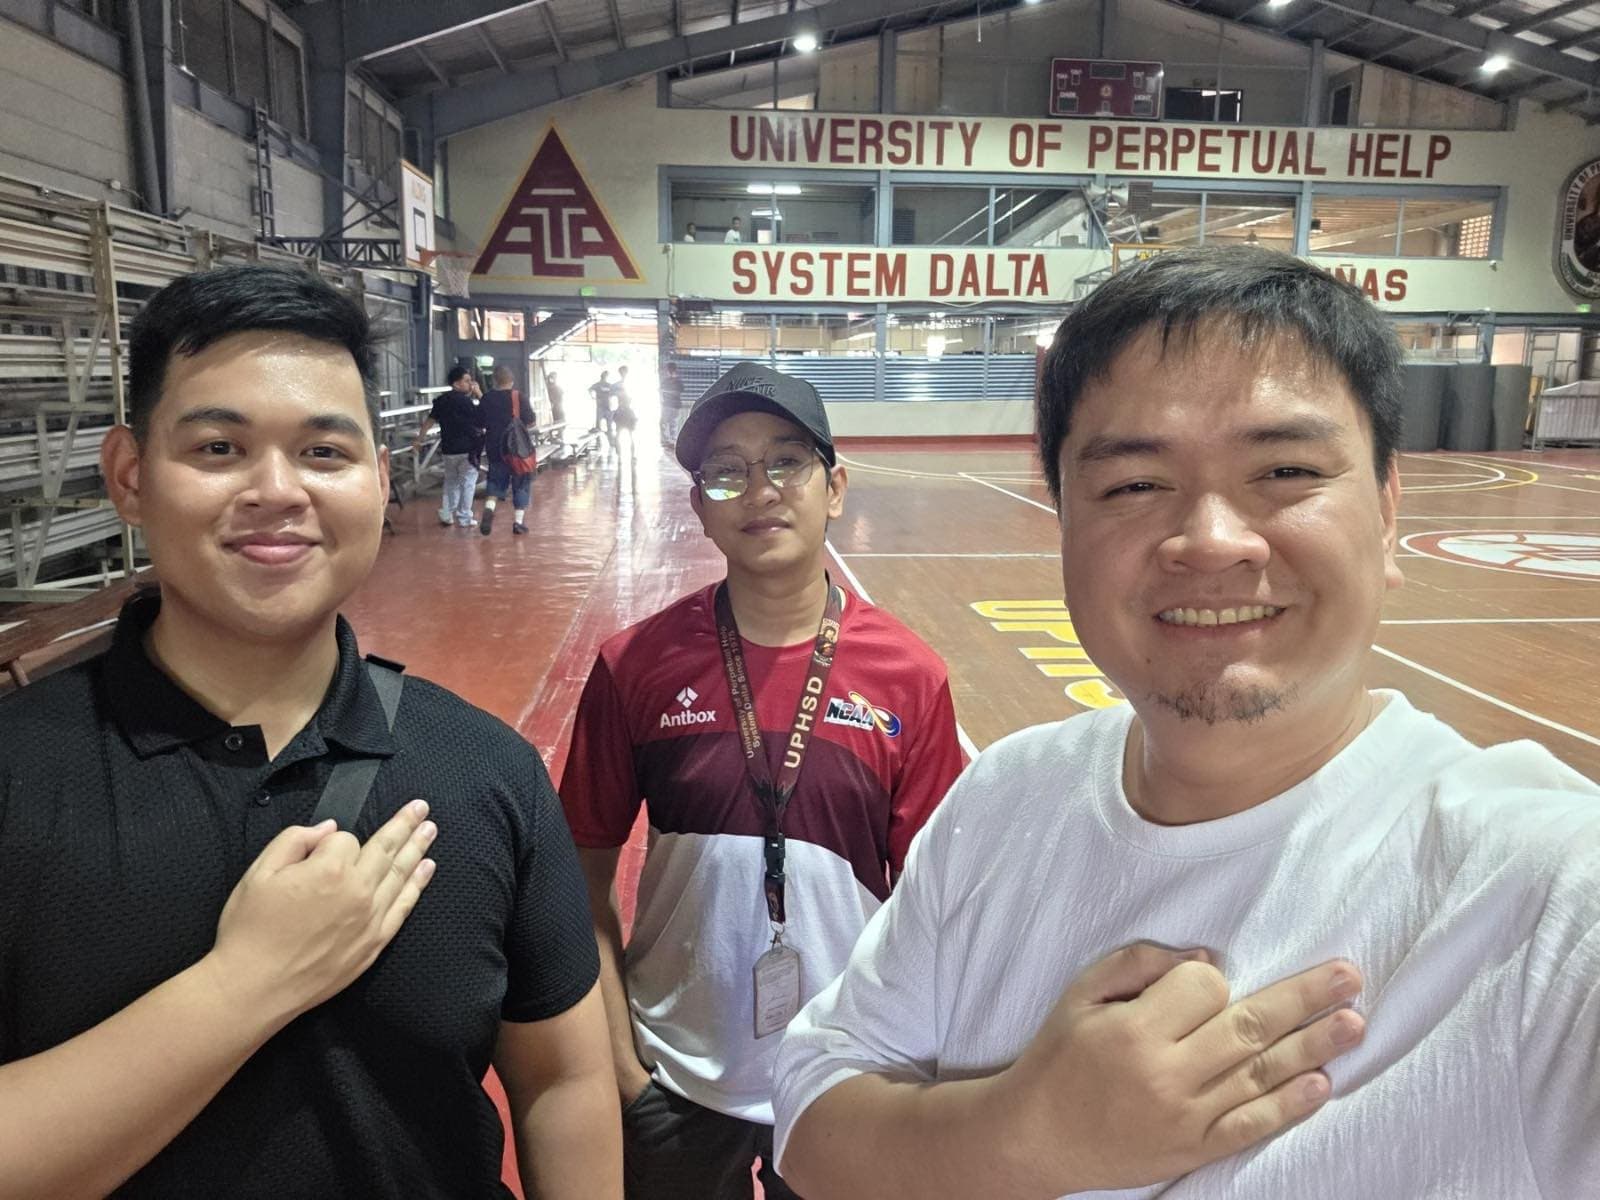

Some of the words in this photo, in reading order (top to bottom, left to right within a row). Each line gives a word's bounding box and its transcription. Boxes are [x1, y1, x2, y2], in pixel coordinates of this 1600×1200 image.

[730, 115, 982, 166] UNIVERSITY
[1009, 123, 1062, 168] OF
[1088, 126, 1327, 175] PERPETUAL
[1347, 133, 1452, 179] HELP
[732, 250, 906, 297] SYSTEM
[929, 253, 1049, 297] DALTA
[1325, 264, 1408, 302] ÑAS
[660, 709, 717, 729] Antbox
[783, 676, 823, 769] UPHSD
[825, 697, 876, 731] NCAA
